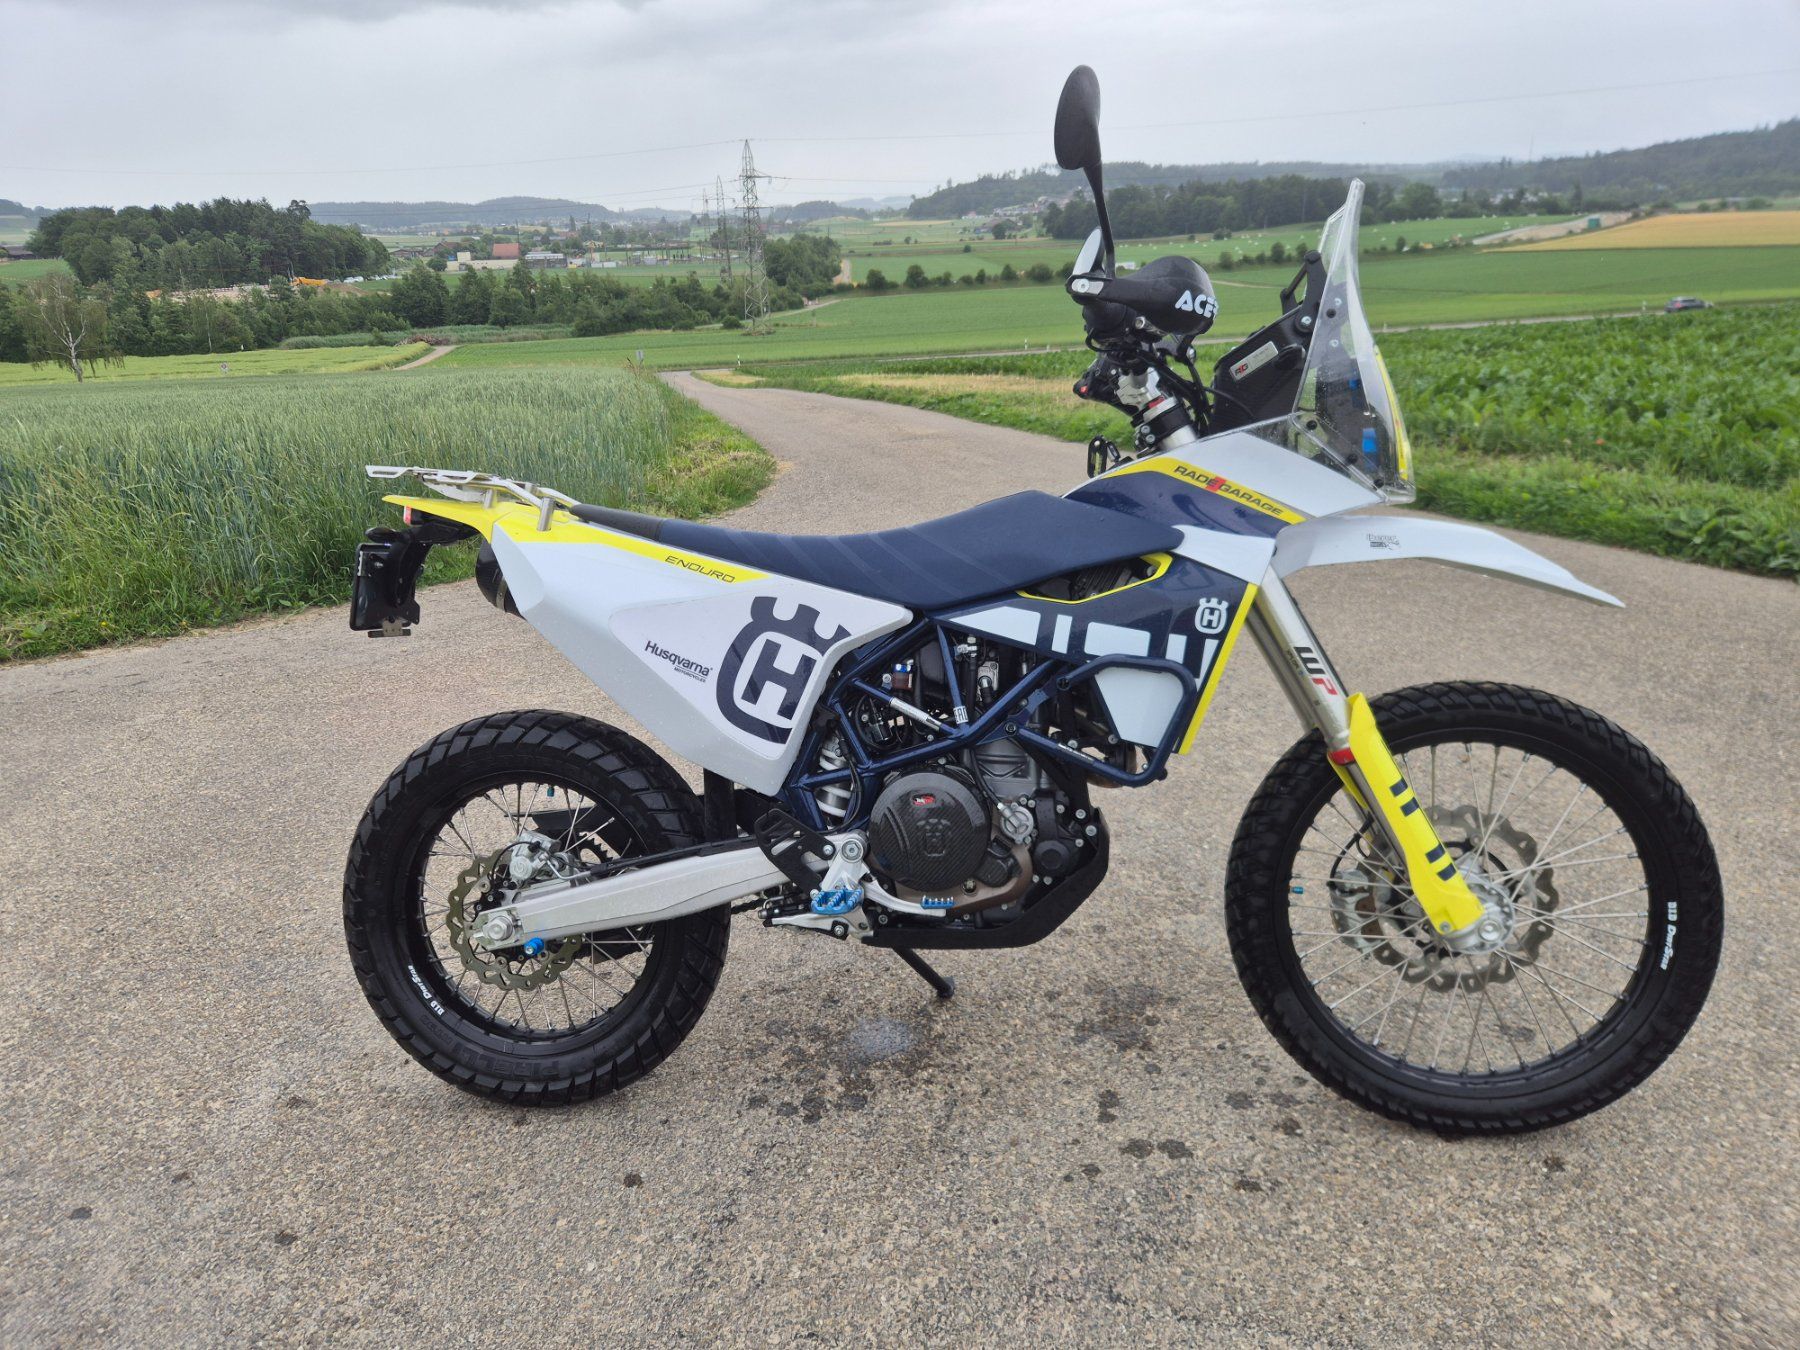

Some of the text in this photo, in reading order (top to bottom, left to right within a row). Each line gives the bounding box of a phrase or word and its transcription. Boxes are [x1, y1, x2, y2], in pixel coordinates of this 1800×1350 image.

[1218, 483, 1285, 516] GARAGE
[664, 555, 736, 583] ENDURO
[644, 640, 711, 677] Husqvarna
[1293, 646, 1338, 695] WP
